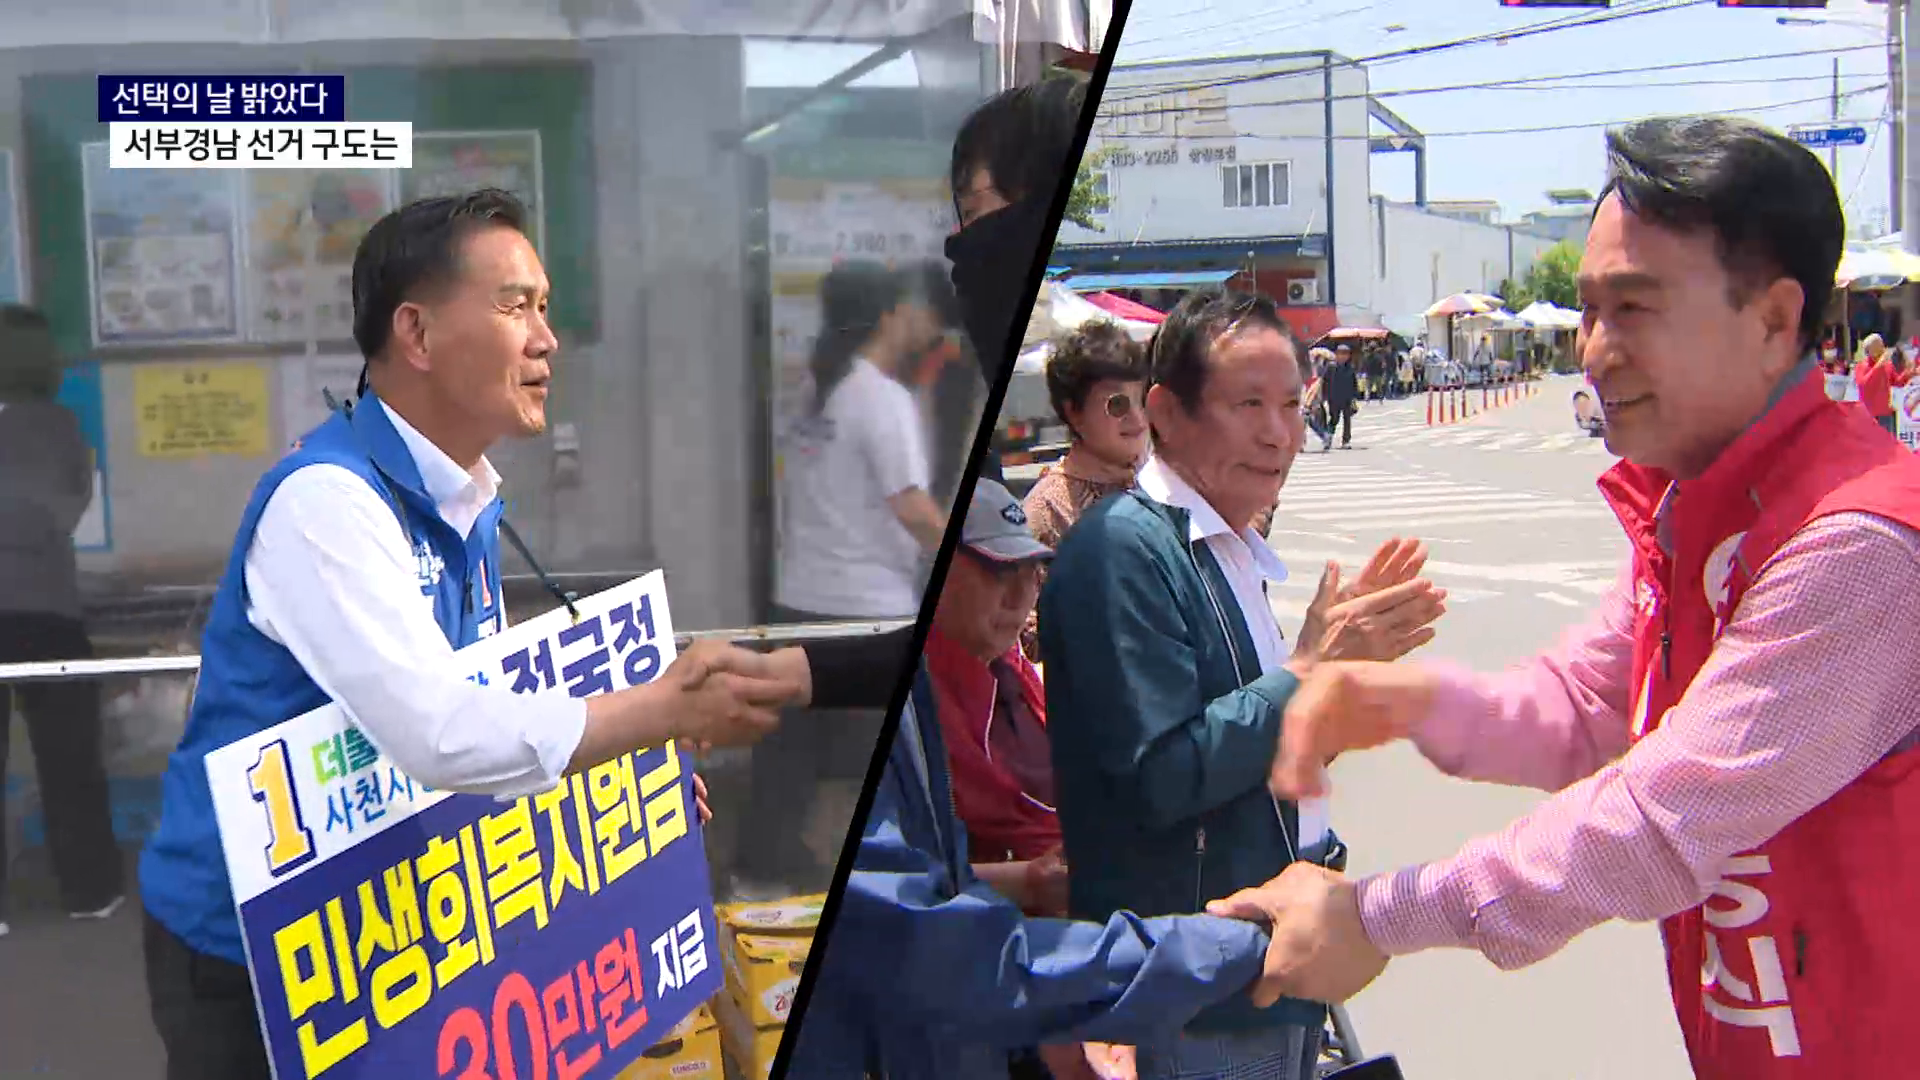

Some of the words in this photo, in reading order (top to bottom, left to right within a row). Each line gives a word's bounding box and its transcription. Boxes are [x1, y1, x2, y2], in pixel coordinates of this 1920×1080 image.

[246, 739, 317, 877] 1
[326, 767, 436, 834] 사천시
[273, 738, 688, 1080] 민생회복지원금
[436, 928, 648, 1080] 30만원
[651, 908, 708, 999] 지급
